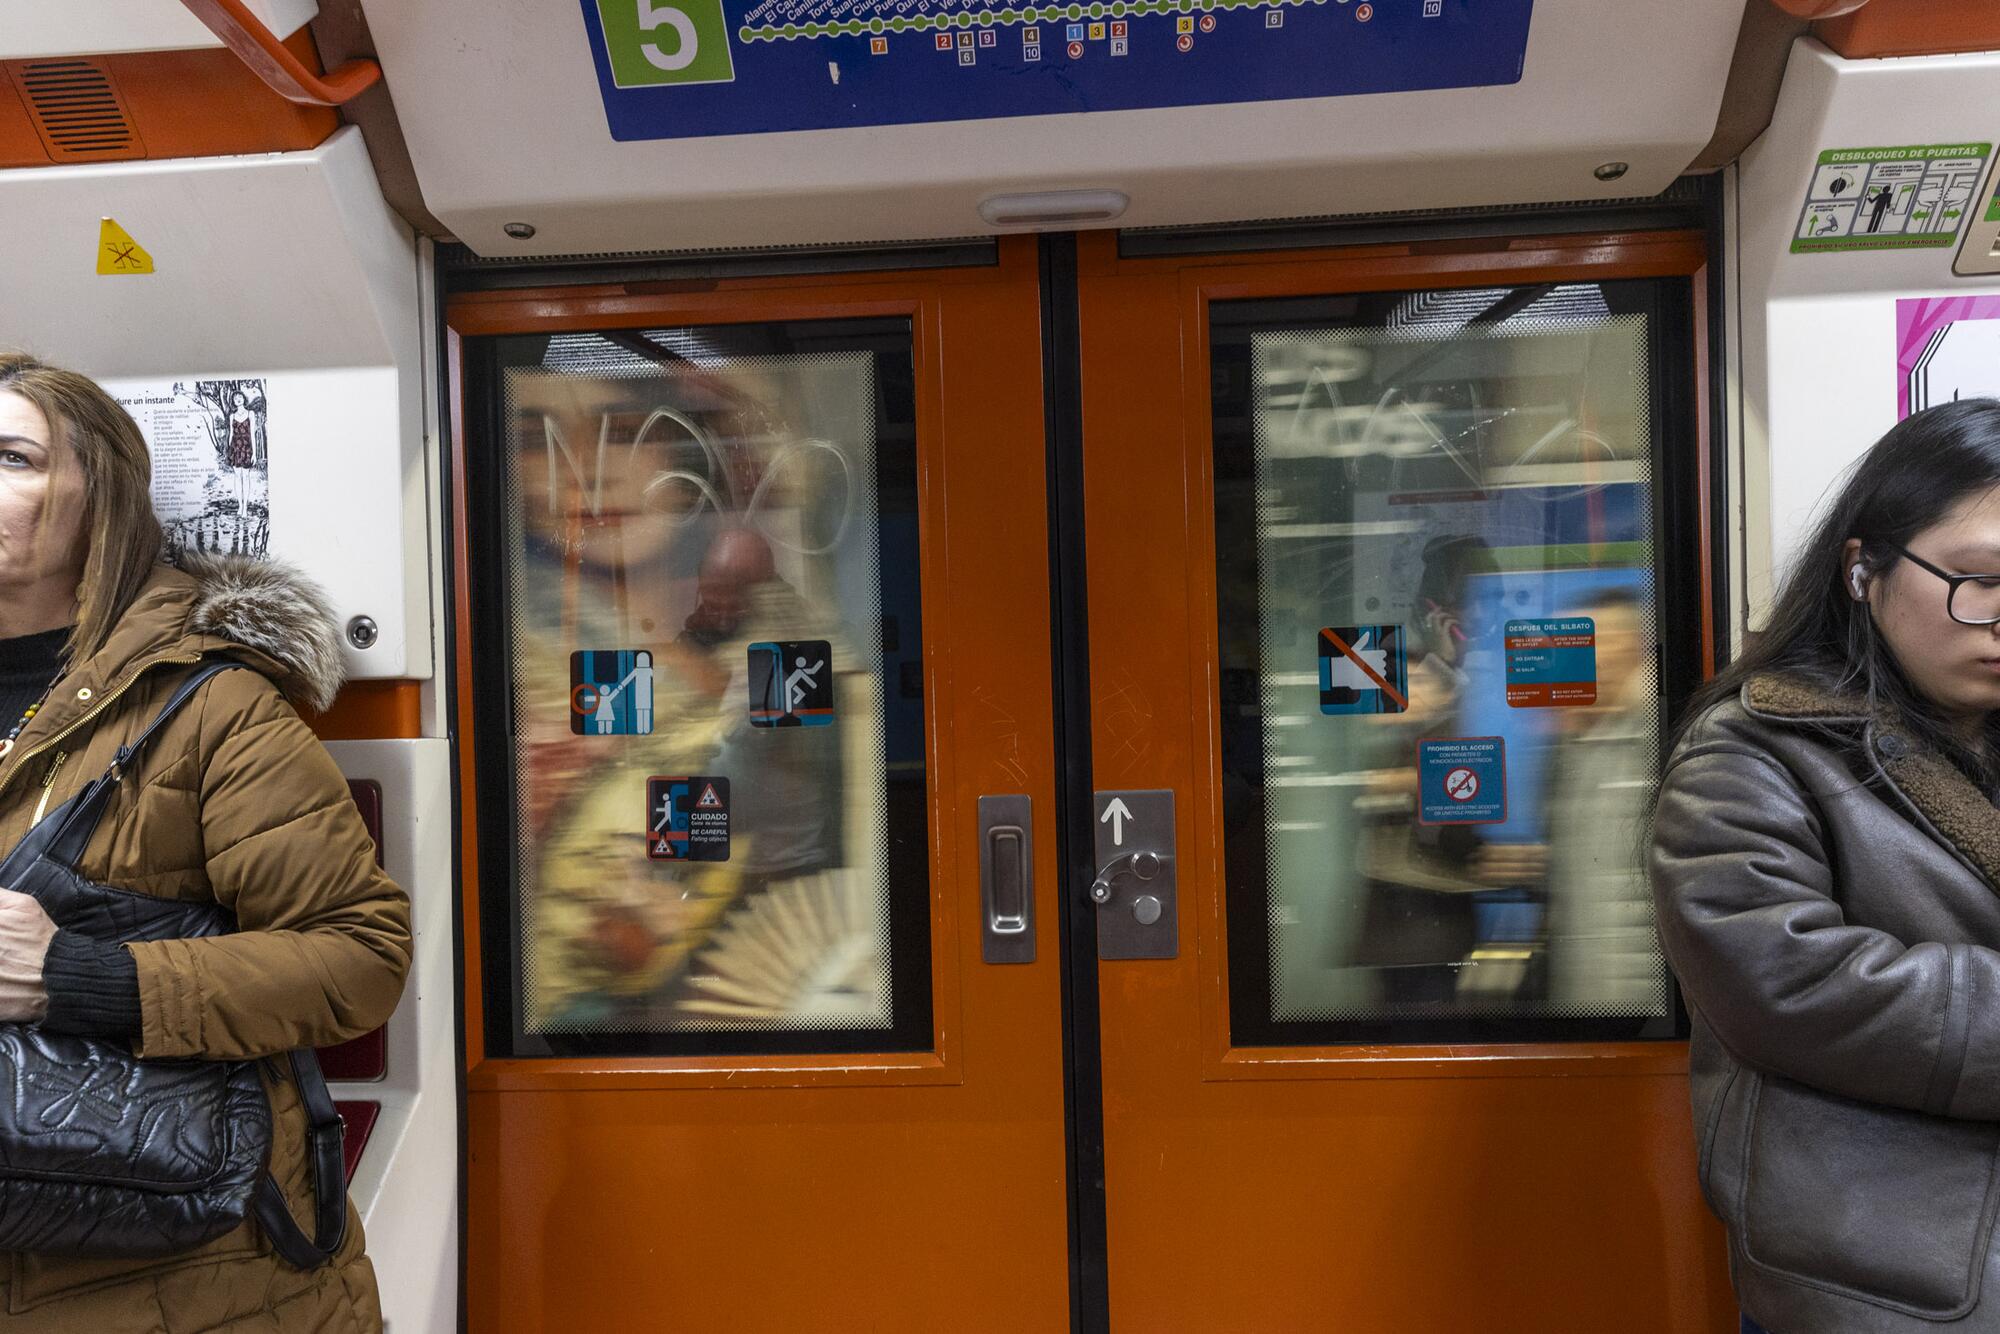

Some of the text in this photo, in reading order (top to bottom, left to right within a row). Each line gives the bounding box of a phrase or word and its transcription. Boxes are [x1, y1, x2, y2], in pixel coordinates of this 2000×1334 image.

[1426, 4, 1438, 13] 10
[765, 10, 777, 23] El
[1271, 15, 1278, 24] 6
[1116, 26, 1122, 34] 2
[1182, 21, 1189, 30] 3
[637, 0, 698, 71] 5
[1094, 26, 1100, 36] 3
[962, 36, 969, 44] 4
[984, 34, 990, 44] 9
[1028, 32, 1034, 40] 4
[876, 42, 882, 50] 7
[941, 38, 947, 47] 2
[964, 53, 970, 62] 6
[1026, 48, 1038, 58] 10
[1832, 146, 1978, 161] DESBLOQUEO DE PUERTAS
